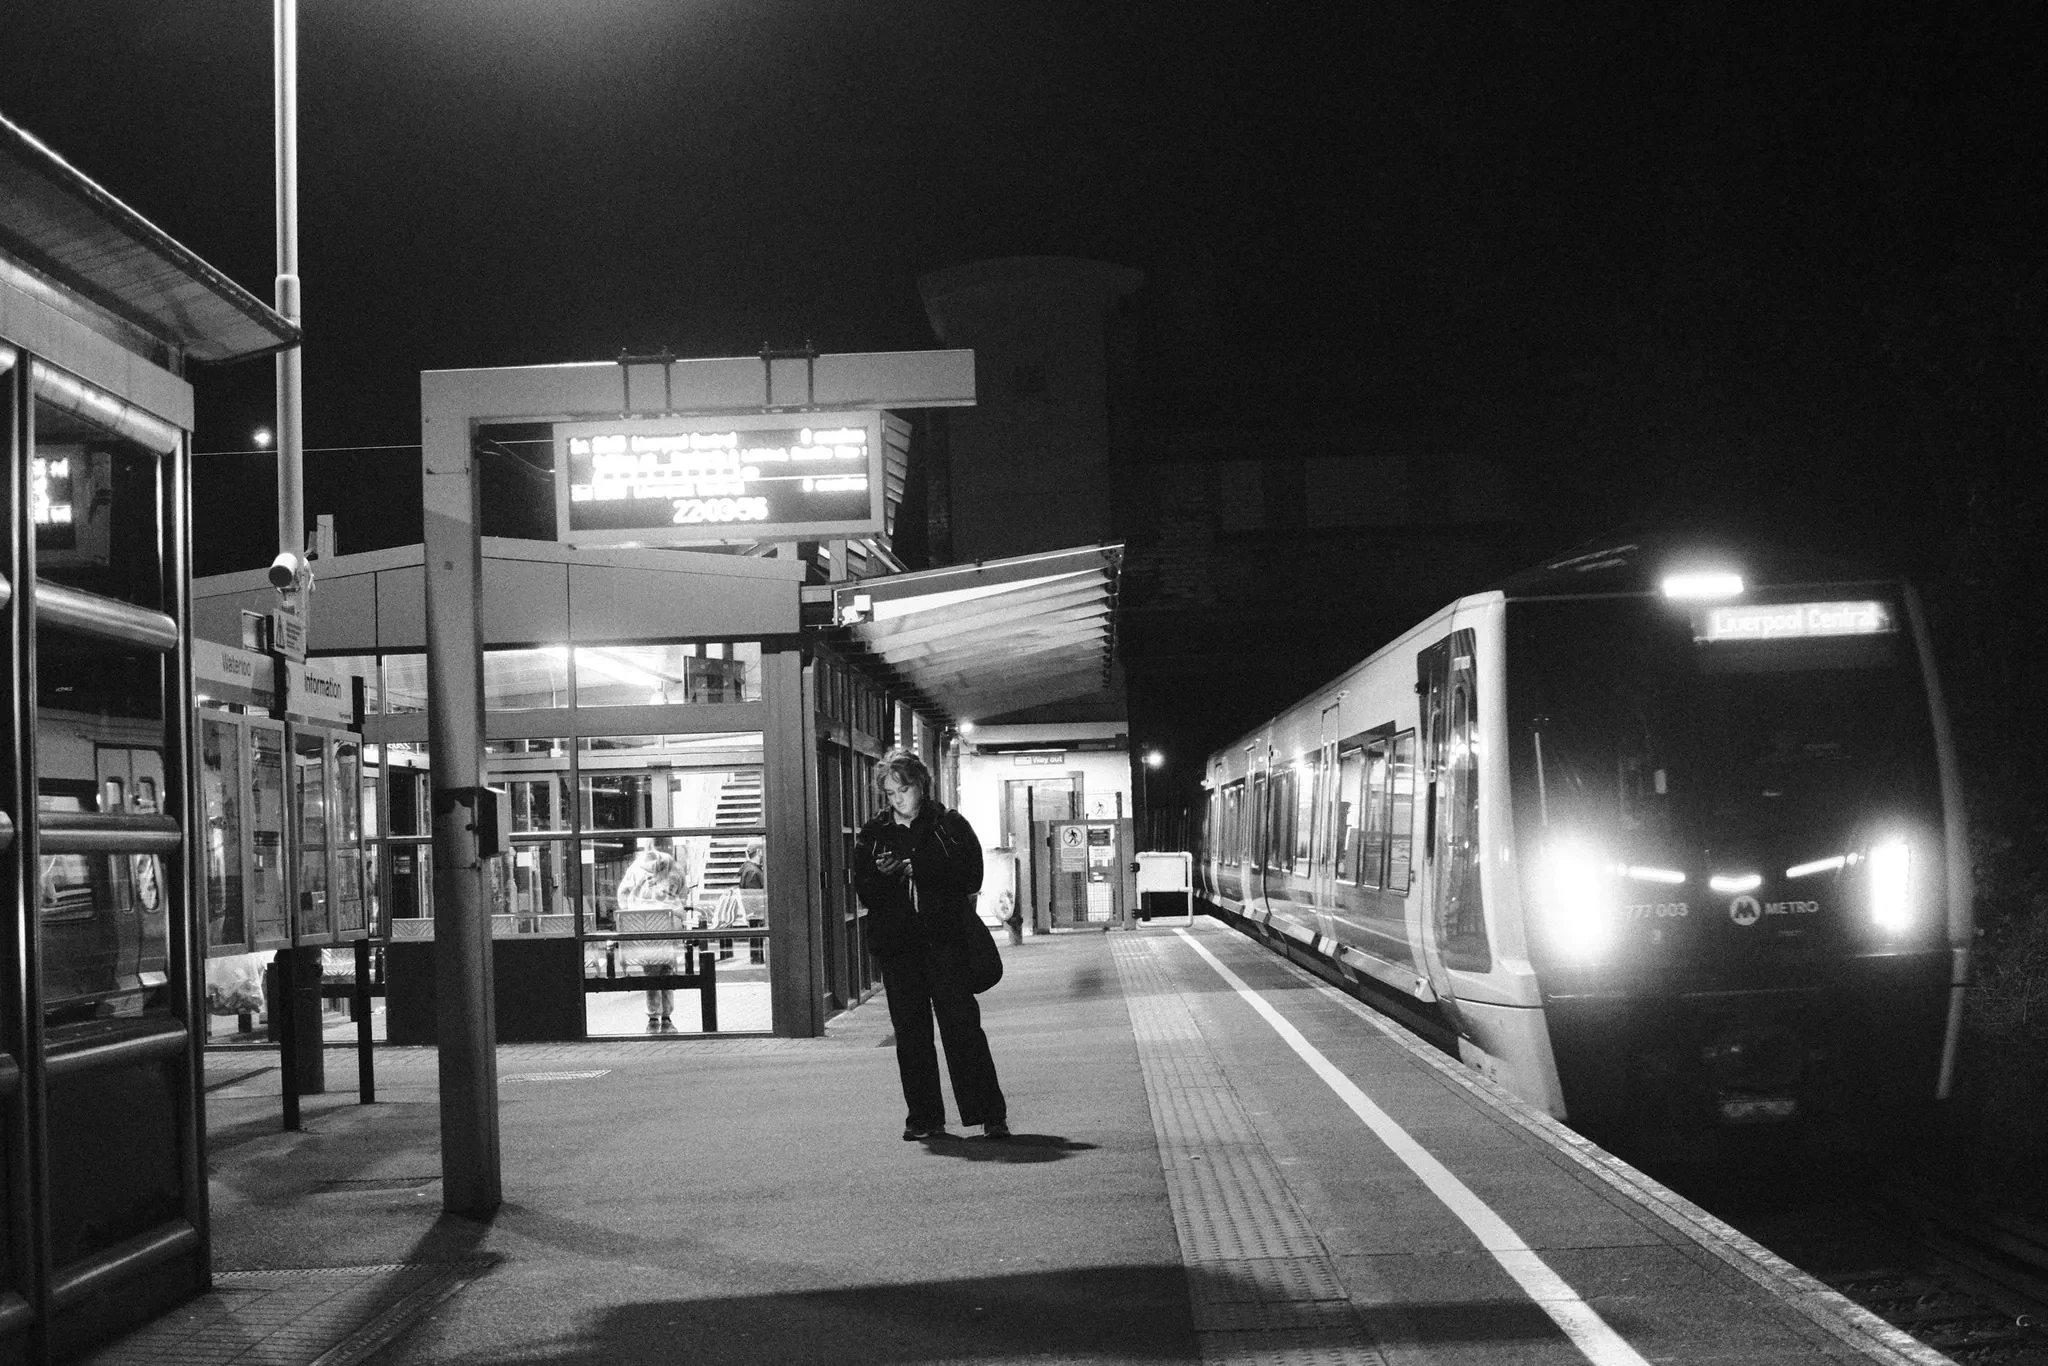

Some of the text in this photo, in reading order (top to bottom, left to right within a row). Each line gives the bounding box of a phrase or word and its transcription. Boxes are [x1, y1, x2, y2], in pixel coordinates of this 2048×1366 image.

[1714, 605, 1877, 636] Liverpool Central
[222, 652, 251, 677] Waterloo
[304, 670, 342, 700] Information
[1033, 756, 1063, 765] Way out
[1656, 903, 1688, 918] 003
[1765, 901, 1819, 915] METRO
